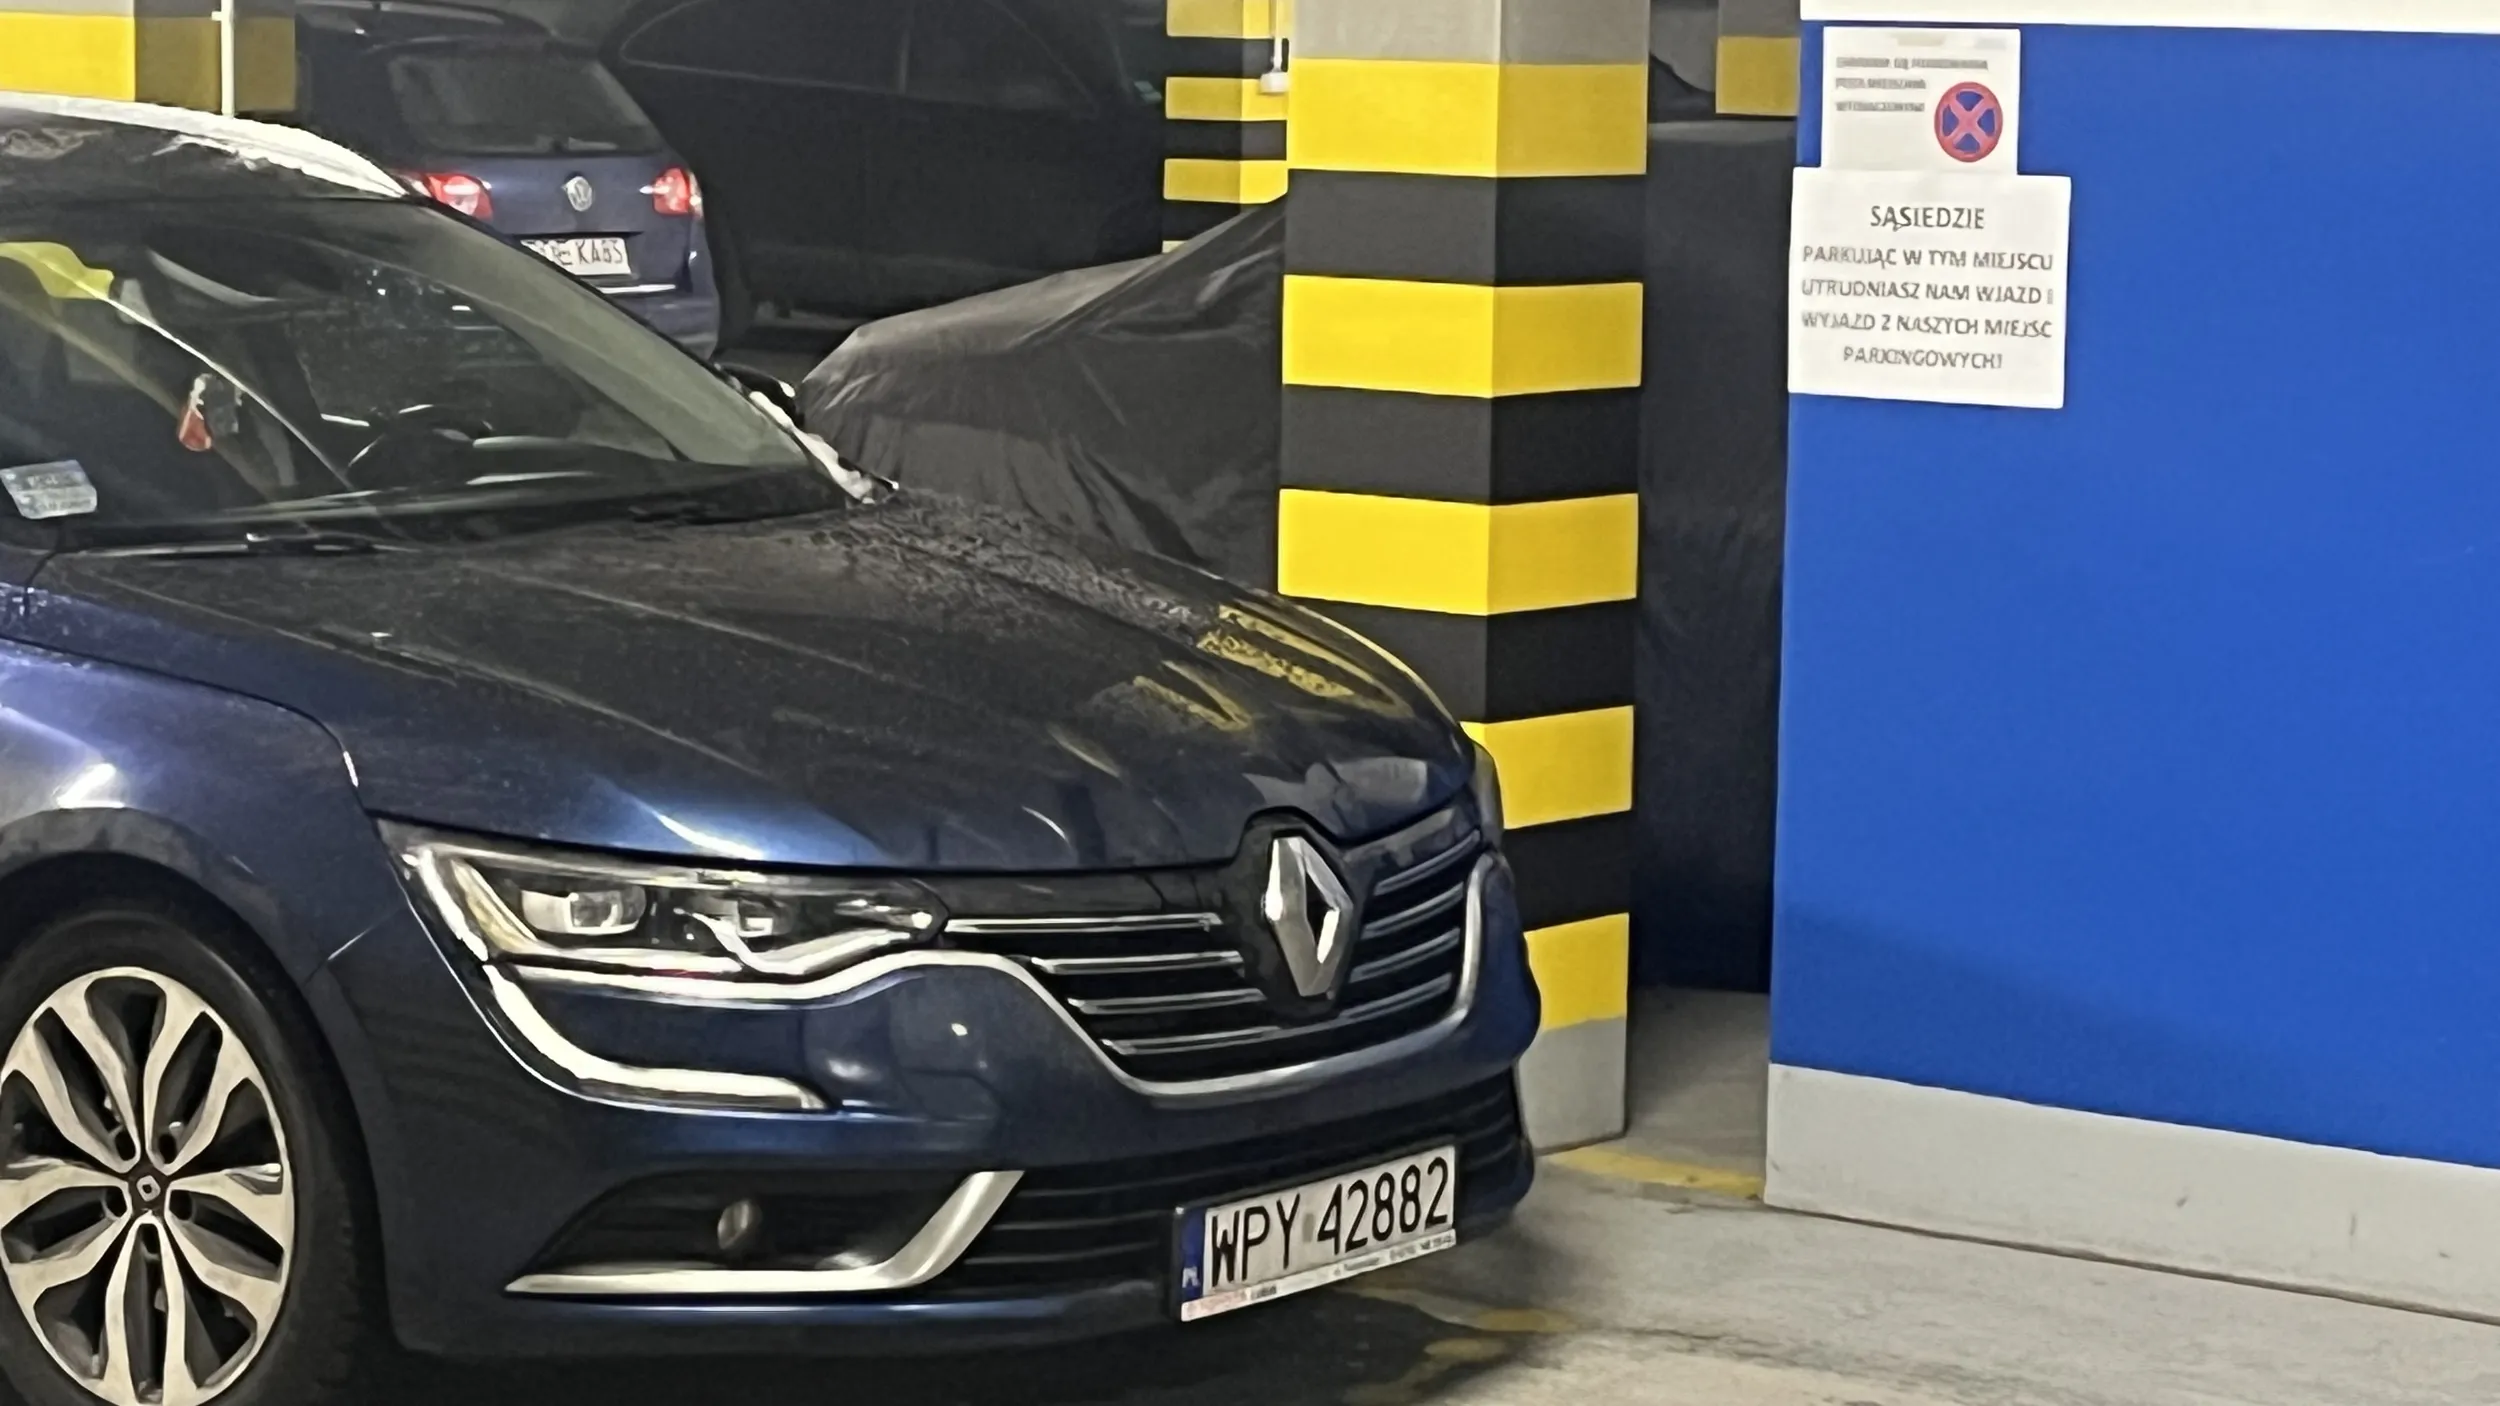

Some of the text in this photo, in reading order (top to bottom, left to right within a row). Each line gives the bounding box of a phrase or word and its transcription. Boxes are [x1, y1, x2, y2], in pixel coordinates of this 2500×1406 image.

[1870, 205, 1985, 231] SĄSIEDZIE
[1803, 245, 2053, 271] PARKUJĄC W TYM MIEJSCU
[1801, 278, 1921, 299] UTRUDNIASZ
[1925, 283, 1970, 301] NAM
[1976, 285, 2042, 304] WJAZD
[1801, 311, 2053, 338] WYJAZD Z NASZYCH MIEJSC
[1211, 1156, 1449, 1288] WPY 42882
